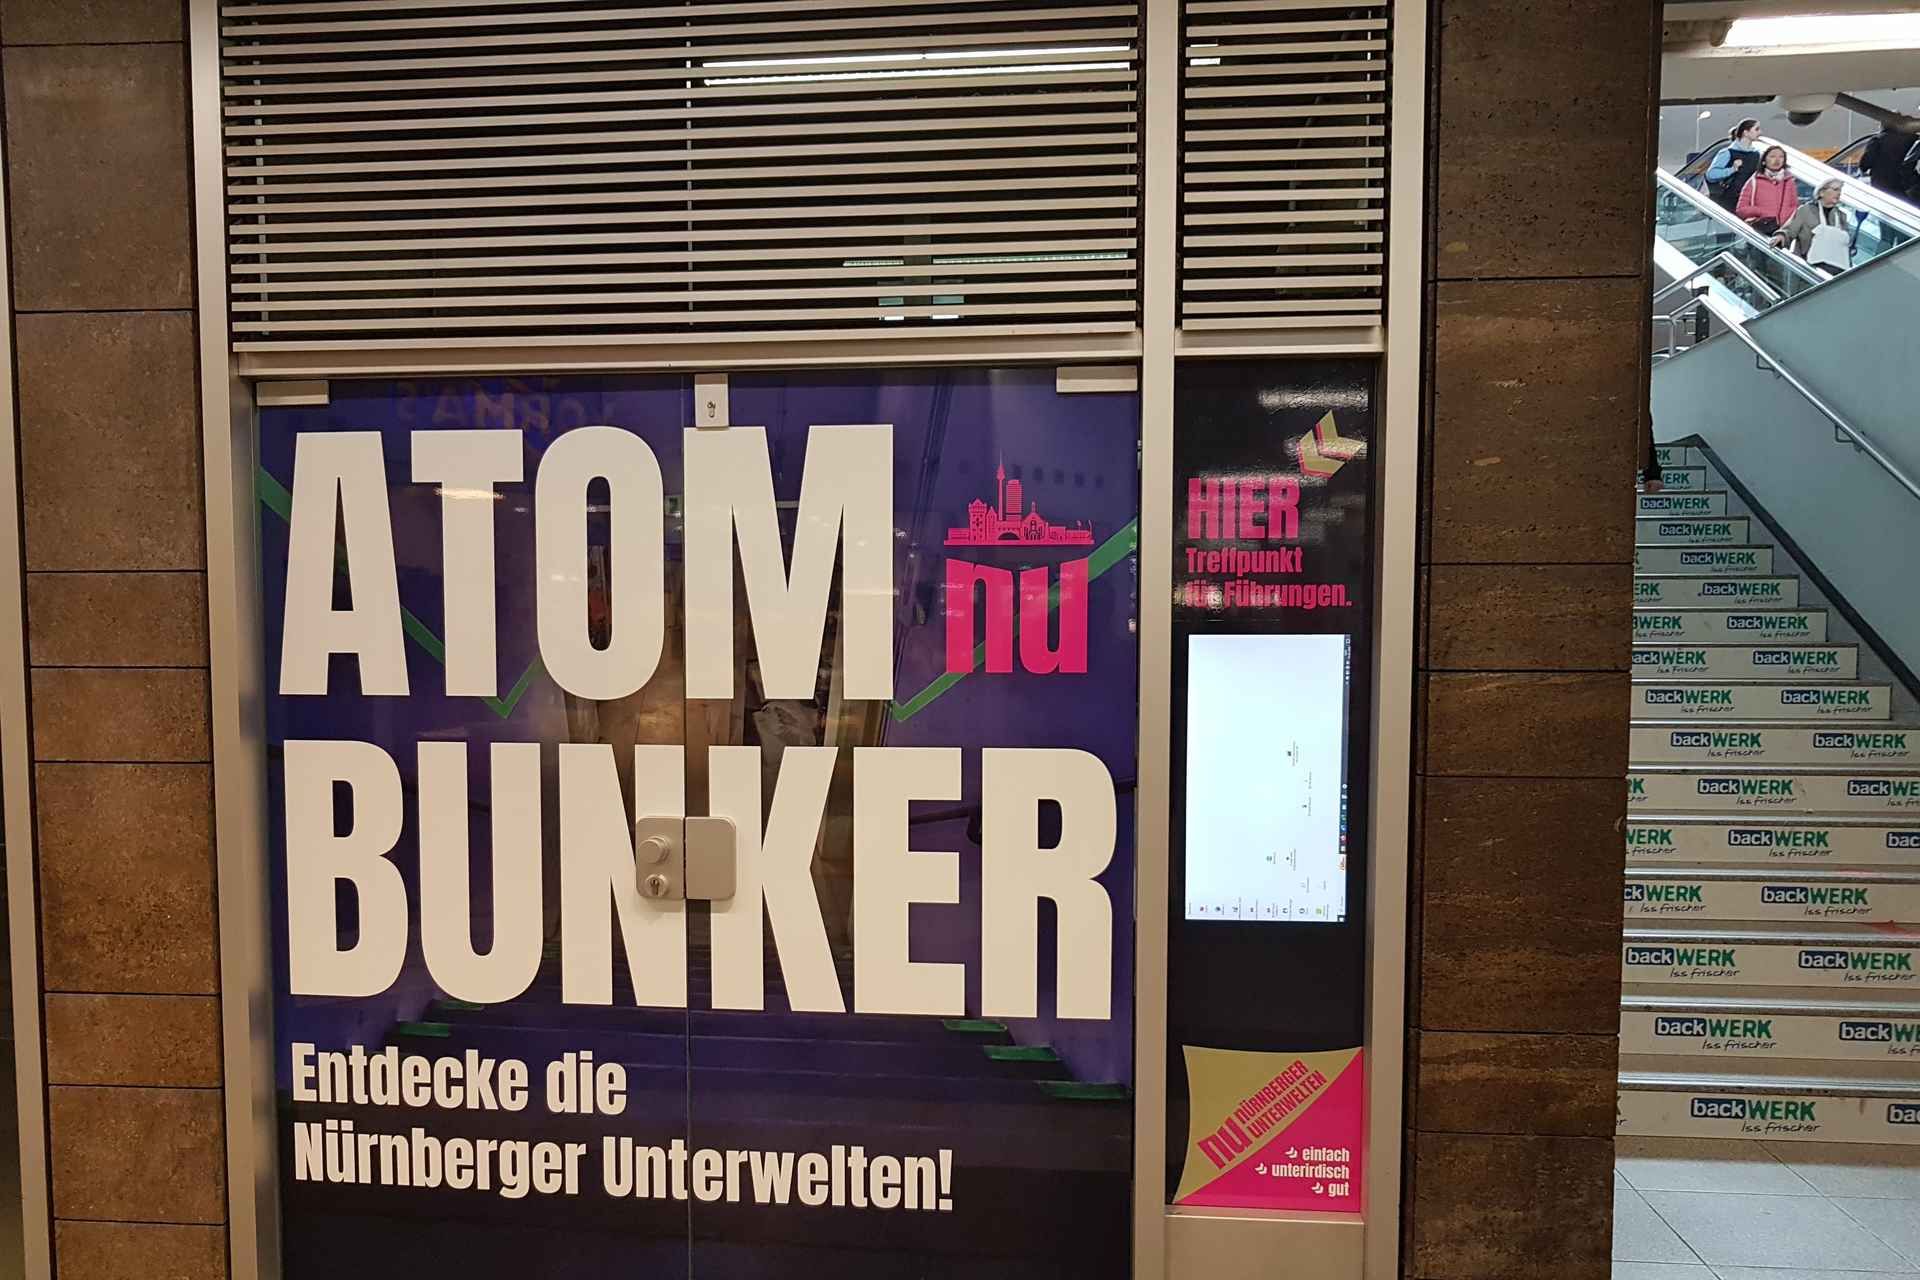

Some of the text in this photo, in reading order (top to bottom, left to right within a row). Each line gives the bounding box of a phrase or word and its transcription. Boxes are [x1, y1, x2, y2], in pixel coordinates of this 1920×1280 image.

[1187, 477, 1300, 540] HIER
[1659, 524, 1731, 537] backWERK
[279, 424, 894, 700] ATOM
[1186, 547, 1303, 576] Treffpunkt
[1681, 552, 1755, 565] backWERK
[1223, 578, 1352, 610] Führungen.
[1703, 583, 1780, 597] backWERK
[945, 558, 1089, 674] nu
[1727, 616, 1808, 630] backWERK
[1632, 651, 1706, 665] ackWERK
[1753, 651, 1837, 665] backWERK
[1646, 689, 1732, 704] backWERK
[1781, 690, 1869, 705] backWERK
[1671, 732, 1761, 748] backWERK
[1813, 733, 1906, 748] backWERK
[1698, 779, 1793, 794] backWERK
[1848, 780, 1920, 796] backWE
[1729, 830, 1829, 847] backWERK
[284, 739, 1117, 1020] BUNKER
[1762, 887, 1868, 905] backWERK
[1627, 948, 1735, 967] backWERK
[1800, 951, 1911, 970] backWERK
[1656, 1018, 1772, 1038] backWERK
[291, 1042, 627, 1115] Entdecke die
[1692, 1099, 1816, 1121] backWERK
[1302, 1147, 1350, 1162] einfach
[294, 1119, 953, 1211] Nürnberger Unterwelten!
[1271, 1163, 1350, 1179] unterirdisch
[1328, 1182, 1350, 1197] gut
